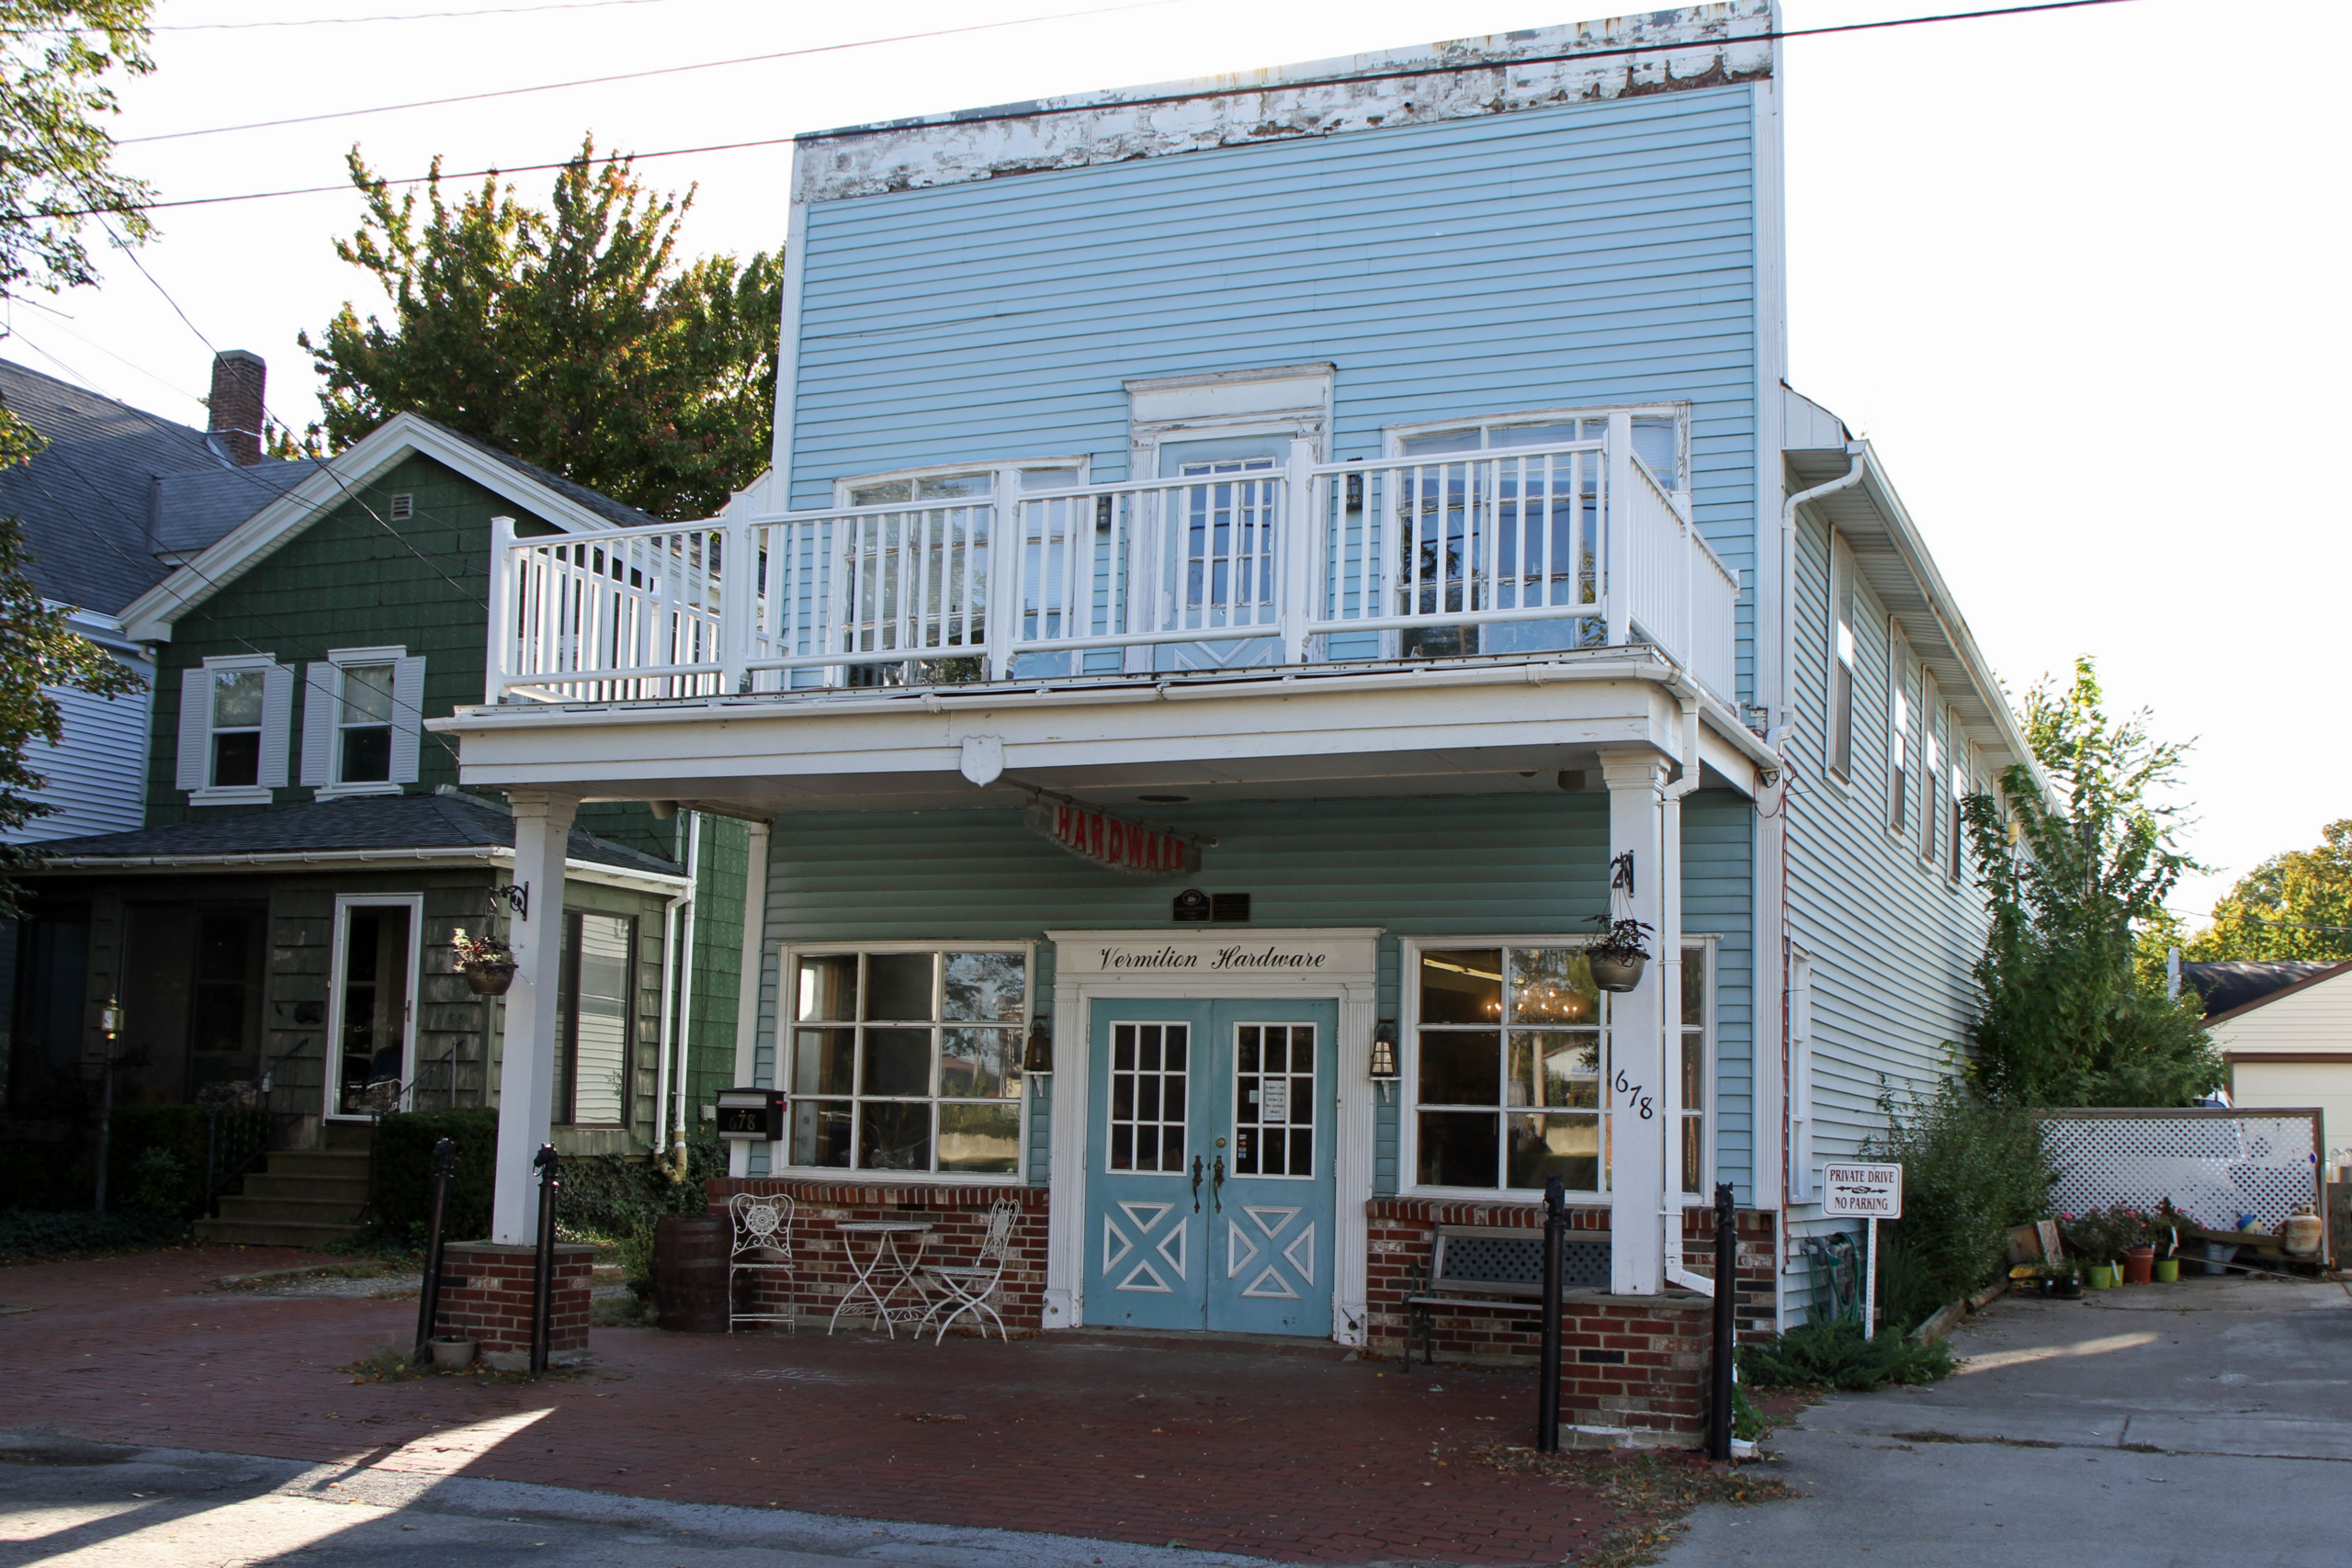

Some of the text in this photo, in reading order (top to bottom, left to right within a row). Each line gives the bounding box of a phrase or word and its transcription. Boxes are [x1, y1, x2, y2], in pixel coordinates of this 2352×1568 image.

[1054, 805, 1187, 870] HARDWARE
[1098, 945, 1326, 971] Vermilion Hardware
[1615, 1068, 1653, 1120] 678
[729, 1113, 756, 1131] 678
[1829, 1169, 1894, 1183] PRIVATE DRIVE
[1834, 1197, 1888, 1210] NO PARKING
